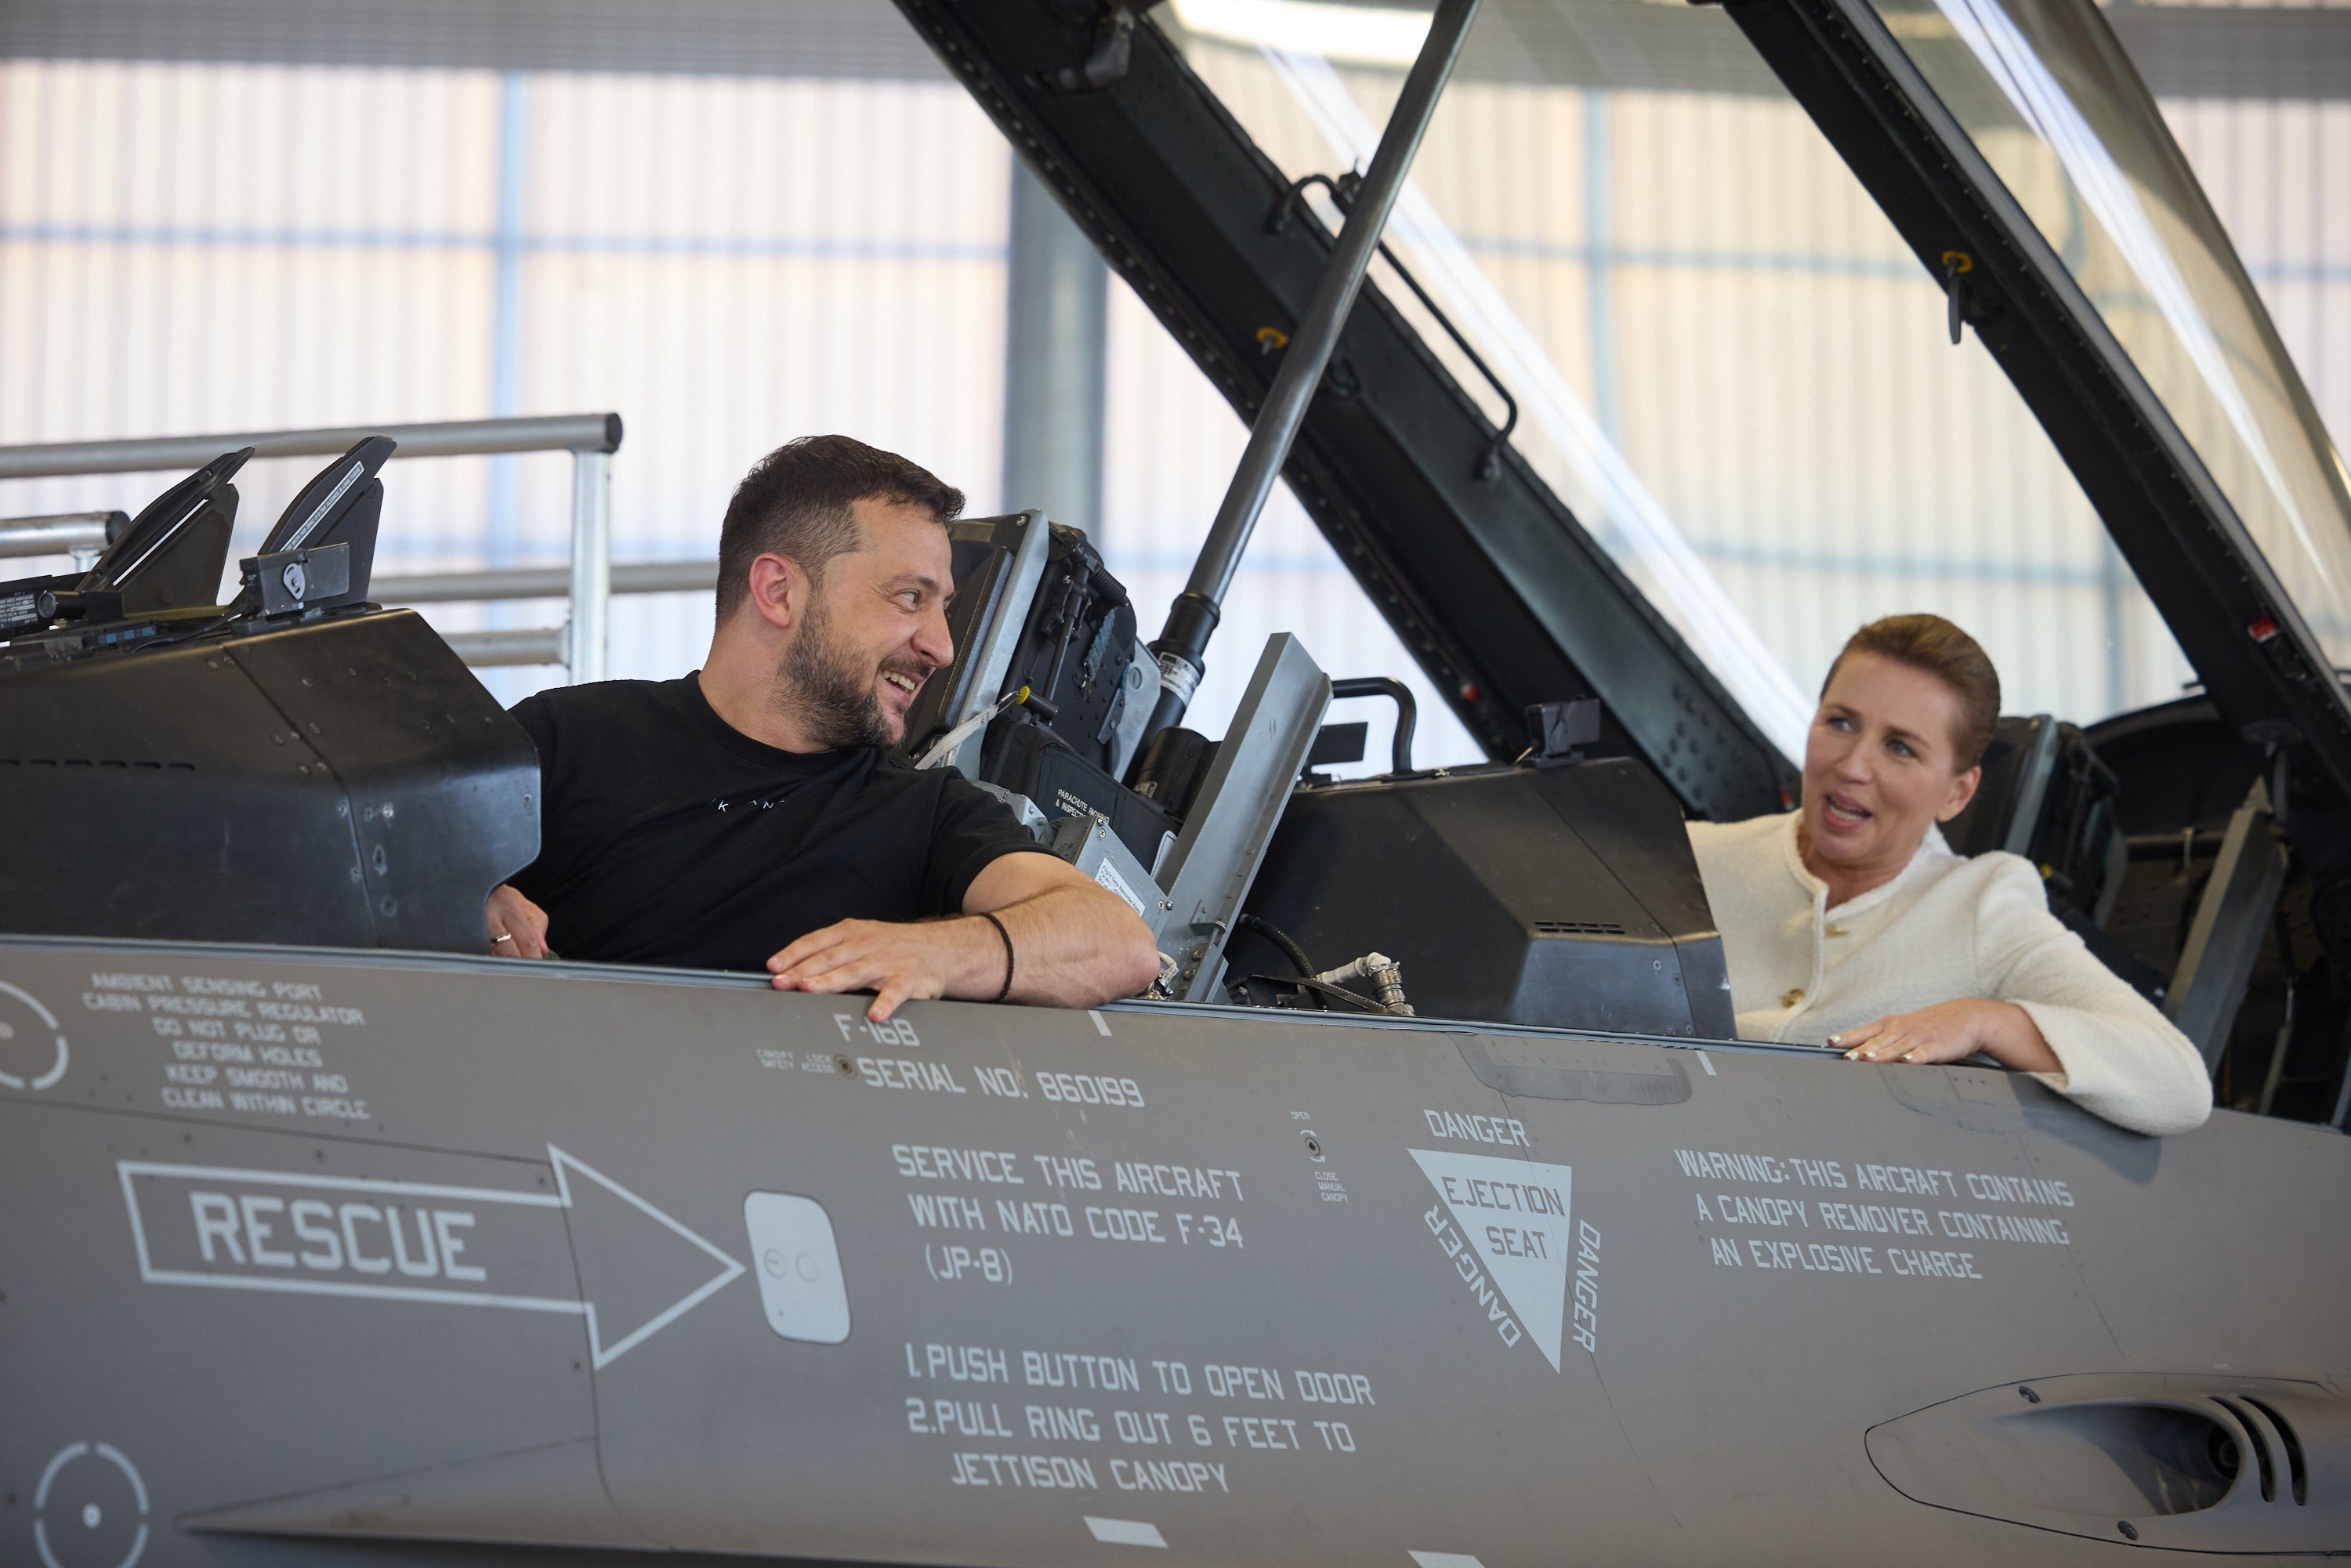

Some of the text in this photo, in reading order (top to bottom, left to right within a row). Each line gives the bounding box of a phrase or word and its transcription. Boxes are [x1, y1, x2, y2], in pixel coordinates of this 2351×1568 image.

[1057, 788, 1088, 812] PARACHUTE
[1061, 802, 1085, 817] INSPECT
[91, 973, 323, 1001] AMBIENT SENSING PORT
[82, 992, 366, 1026] CABIN PRESSURE REGULATOR
[152, 1018, 322, 1045] DO NOT PLUG OR
[172, 1041, 324, 1068] DEFORM HOLES
[165, 1064, 349, 1093] KEEP SMOOTH AND
[857, 1058, 1144, 1107] SERIAL NO. 860199
[161, 1087, 371, 1120] CLEAN WITHIN CIRCLE
[1290, 1111, 1310, 1120] OPEN
[1424, 1110, 1530, 1146] DANGER
[893, 1145, 1243, 1200] SERVICE THIS AIRCRAFT
[1314, 1171, 1338, 1181] CLOSE
[1317, 1182, 1346, 1191] MANUAL
[1856, 1164, 1957, 1197] AIRCRAFT
[1965, 1173, 2074, 1206] CONTAINS
[1321, 1192, 1348, 1202] CANOPY
[1442, 1177, 1565, 1216] EJECTION
[190, 1193, 487, 1281] RESCUE
[907, 1194, 985, 1229] WITH
[996, 1200, 1073, 1236] NATO
[1086, 1207, 1165, 1243] CODE
[1697, 1194, 2070, 1244] A CANOPY REMOVER CONTAINING
[1486, 1226, 1547, 1259] SEAT
[1711, 1238, 1983, 1279] AN EXPLOSIVE CHARGE
[926, 1244, 1012, 1285] (JP-8)
[1424, 1204, 1522, 1348] DANGER
[1574, 1219, 1600, 1353] DANGER
[1023, 1351, 1139, 1392] BUTTON
[1152, 1360, 1192, 1394] TO
[1204, 1365, 1284, 1400] OPEN
[1295, 1371, 1375, 1405] DOOR
[1025, 1406, 1100, 1441] RING
[1114, 1410, 1171, 1444] OUT
[1187, 1415, 1212, 1446] 6
[1223, 1417, 1299, 1449] FEET
[1313, 1421, 1356, 1452] TO
[952, 1453, 1228, 1492] JETTISON CANOPY
